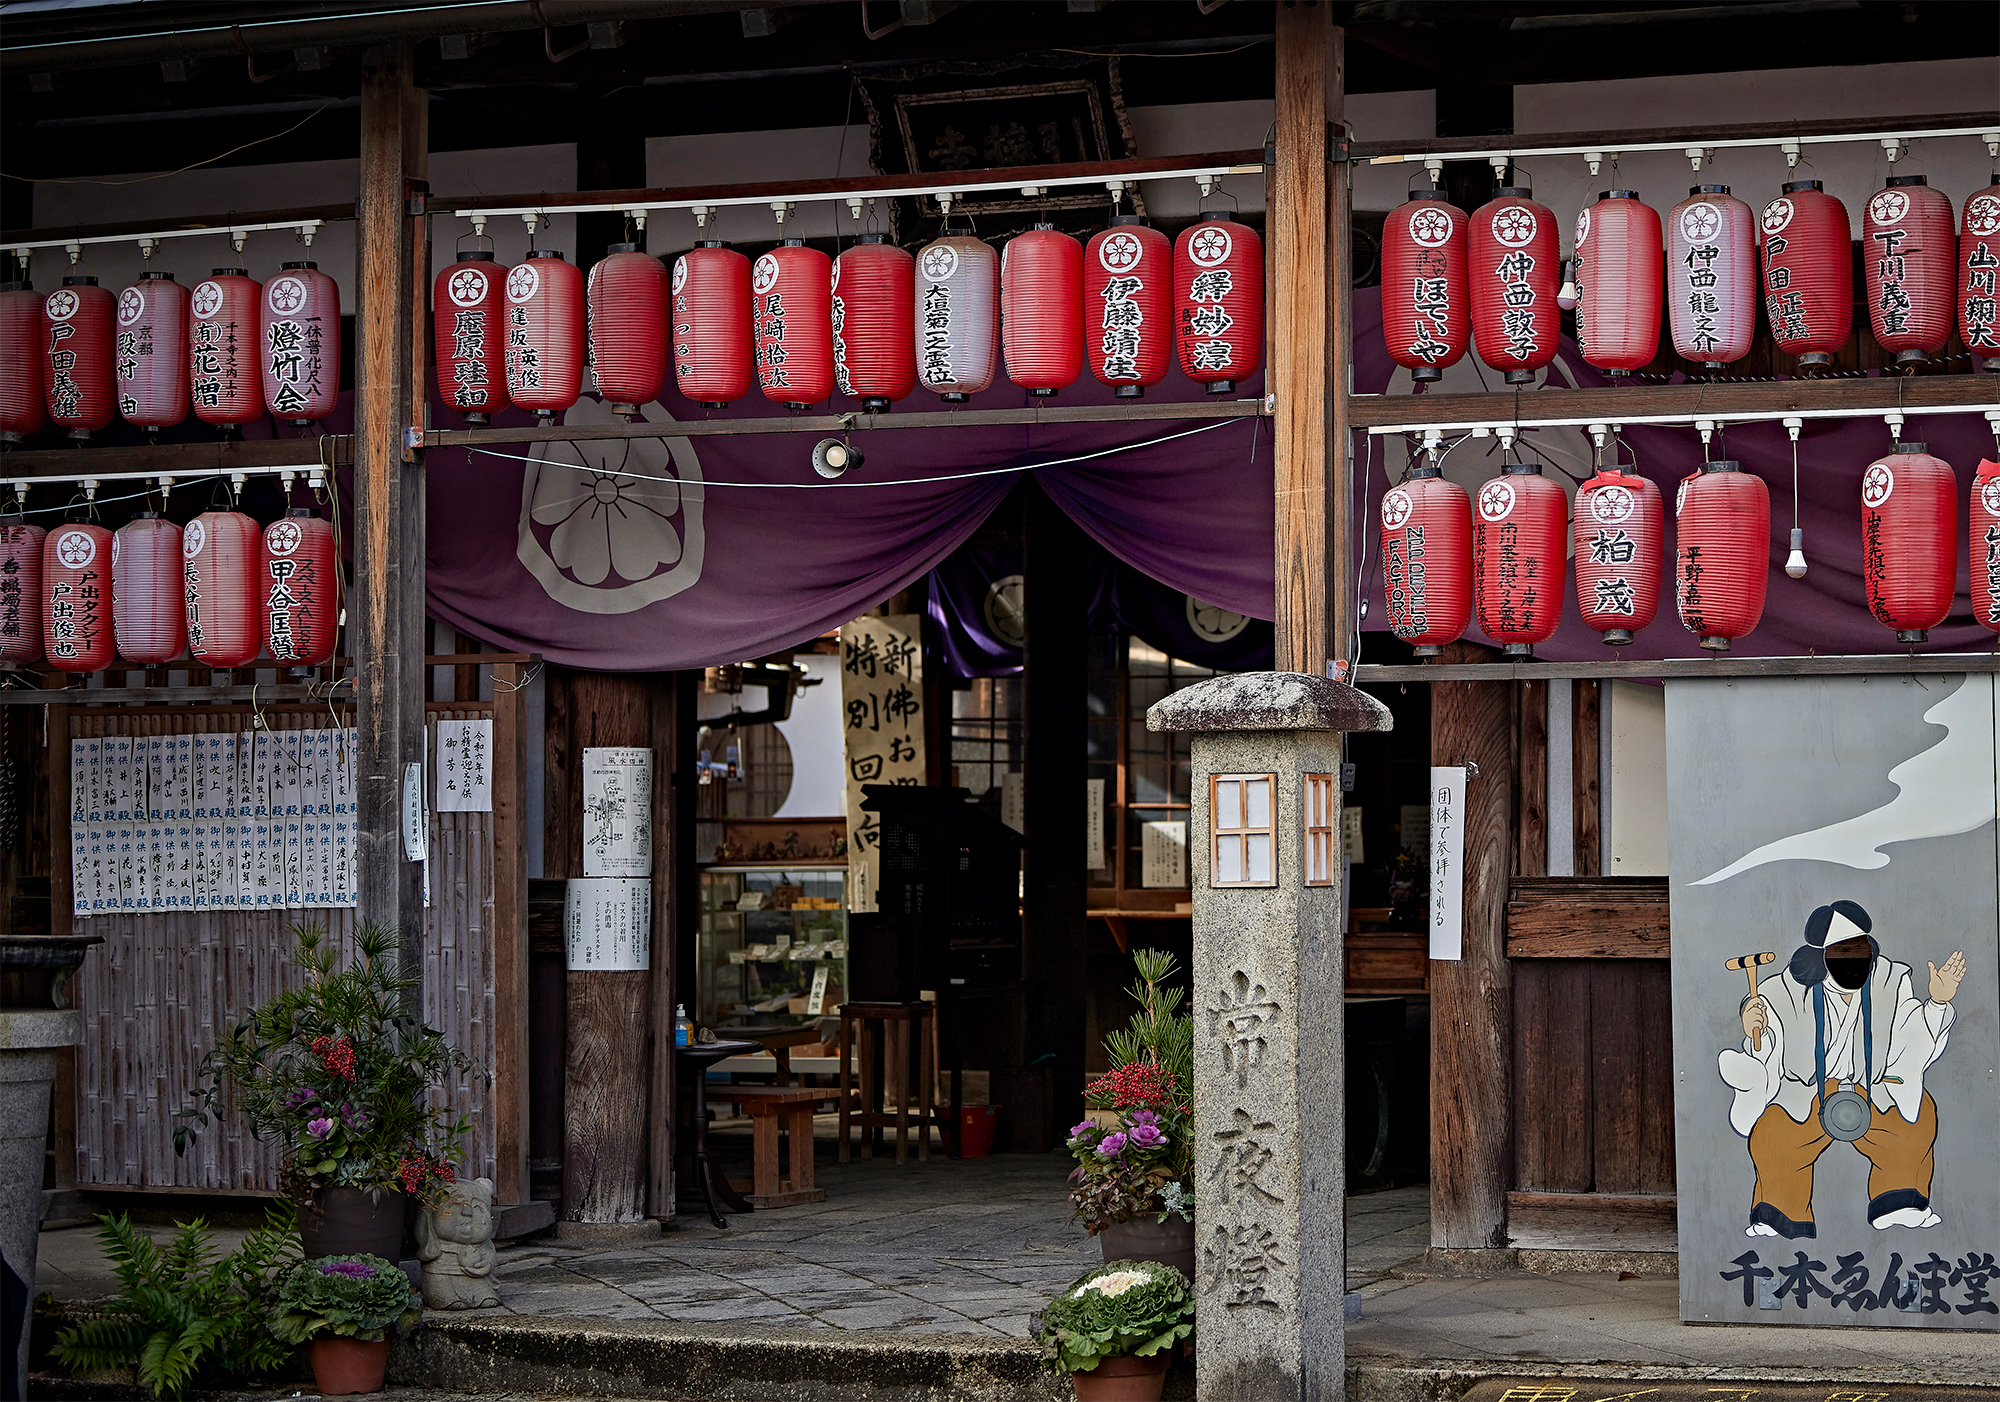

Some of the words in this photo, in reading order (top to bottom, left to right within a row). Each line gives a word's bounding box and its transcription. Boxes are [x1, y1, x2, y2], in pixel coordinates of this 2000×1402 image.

[1496, 250, 1538, 361] 仲西敦子
[1681, 244, 1722, 353] 仲西龍之介
[1765, 235, 1791, 291] 戸田
[1872, 228, 1912, 337] 下川義重
[1964, 241, 2000, 348] 山川翔大
[138, 325, 153, 355] 京都
[305, 316, 323, 396] 一休普化尺八
[923, 283, 958, 385] 大垣菊一之霊位
[1101, 276, 1143, 381] 伊藤靖生
[1409, 277, 1451, 364] ほていや
[1781, 291, 1811, 341] 正義
[49, 322, 82, 418] 戸田義雄
[225, 322, 238, 398] 千本寺之内上ル
[267, 320, 309, 412] 燈竹会
[519, 348, 543, 389] 英俊
[51, 582, 78, 659] 戸出俊也
[78, 570, 99, 651] 戸出タクシー
[184, 560, 207, 656] 長谷川博一
[1388, 539, 1406, 625] FACTORY
[1408, 562, 1430, 634] DEVELOP
[1498, 522, 1519, 633] 市川家先祖代々之霊位
[1684, 546, 1707, 632] 平野嘉一郎
[846, 633, 883, 853] 特別回向
[880, 633, 920, 785] 新佛お
[444, 737, 457, 791] 御芳名
[473, 731, 485, 786] 令和六年度
[1436, 787, 1453, 927] 団体で参拝される
[1205, 970, 1287, 1315] 常夜燈
[1719, 1249, 2000, 1315] 千本ゑんま堂
